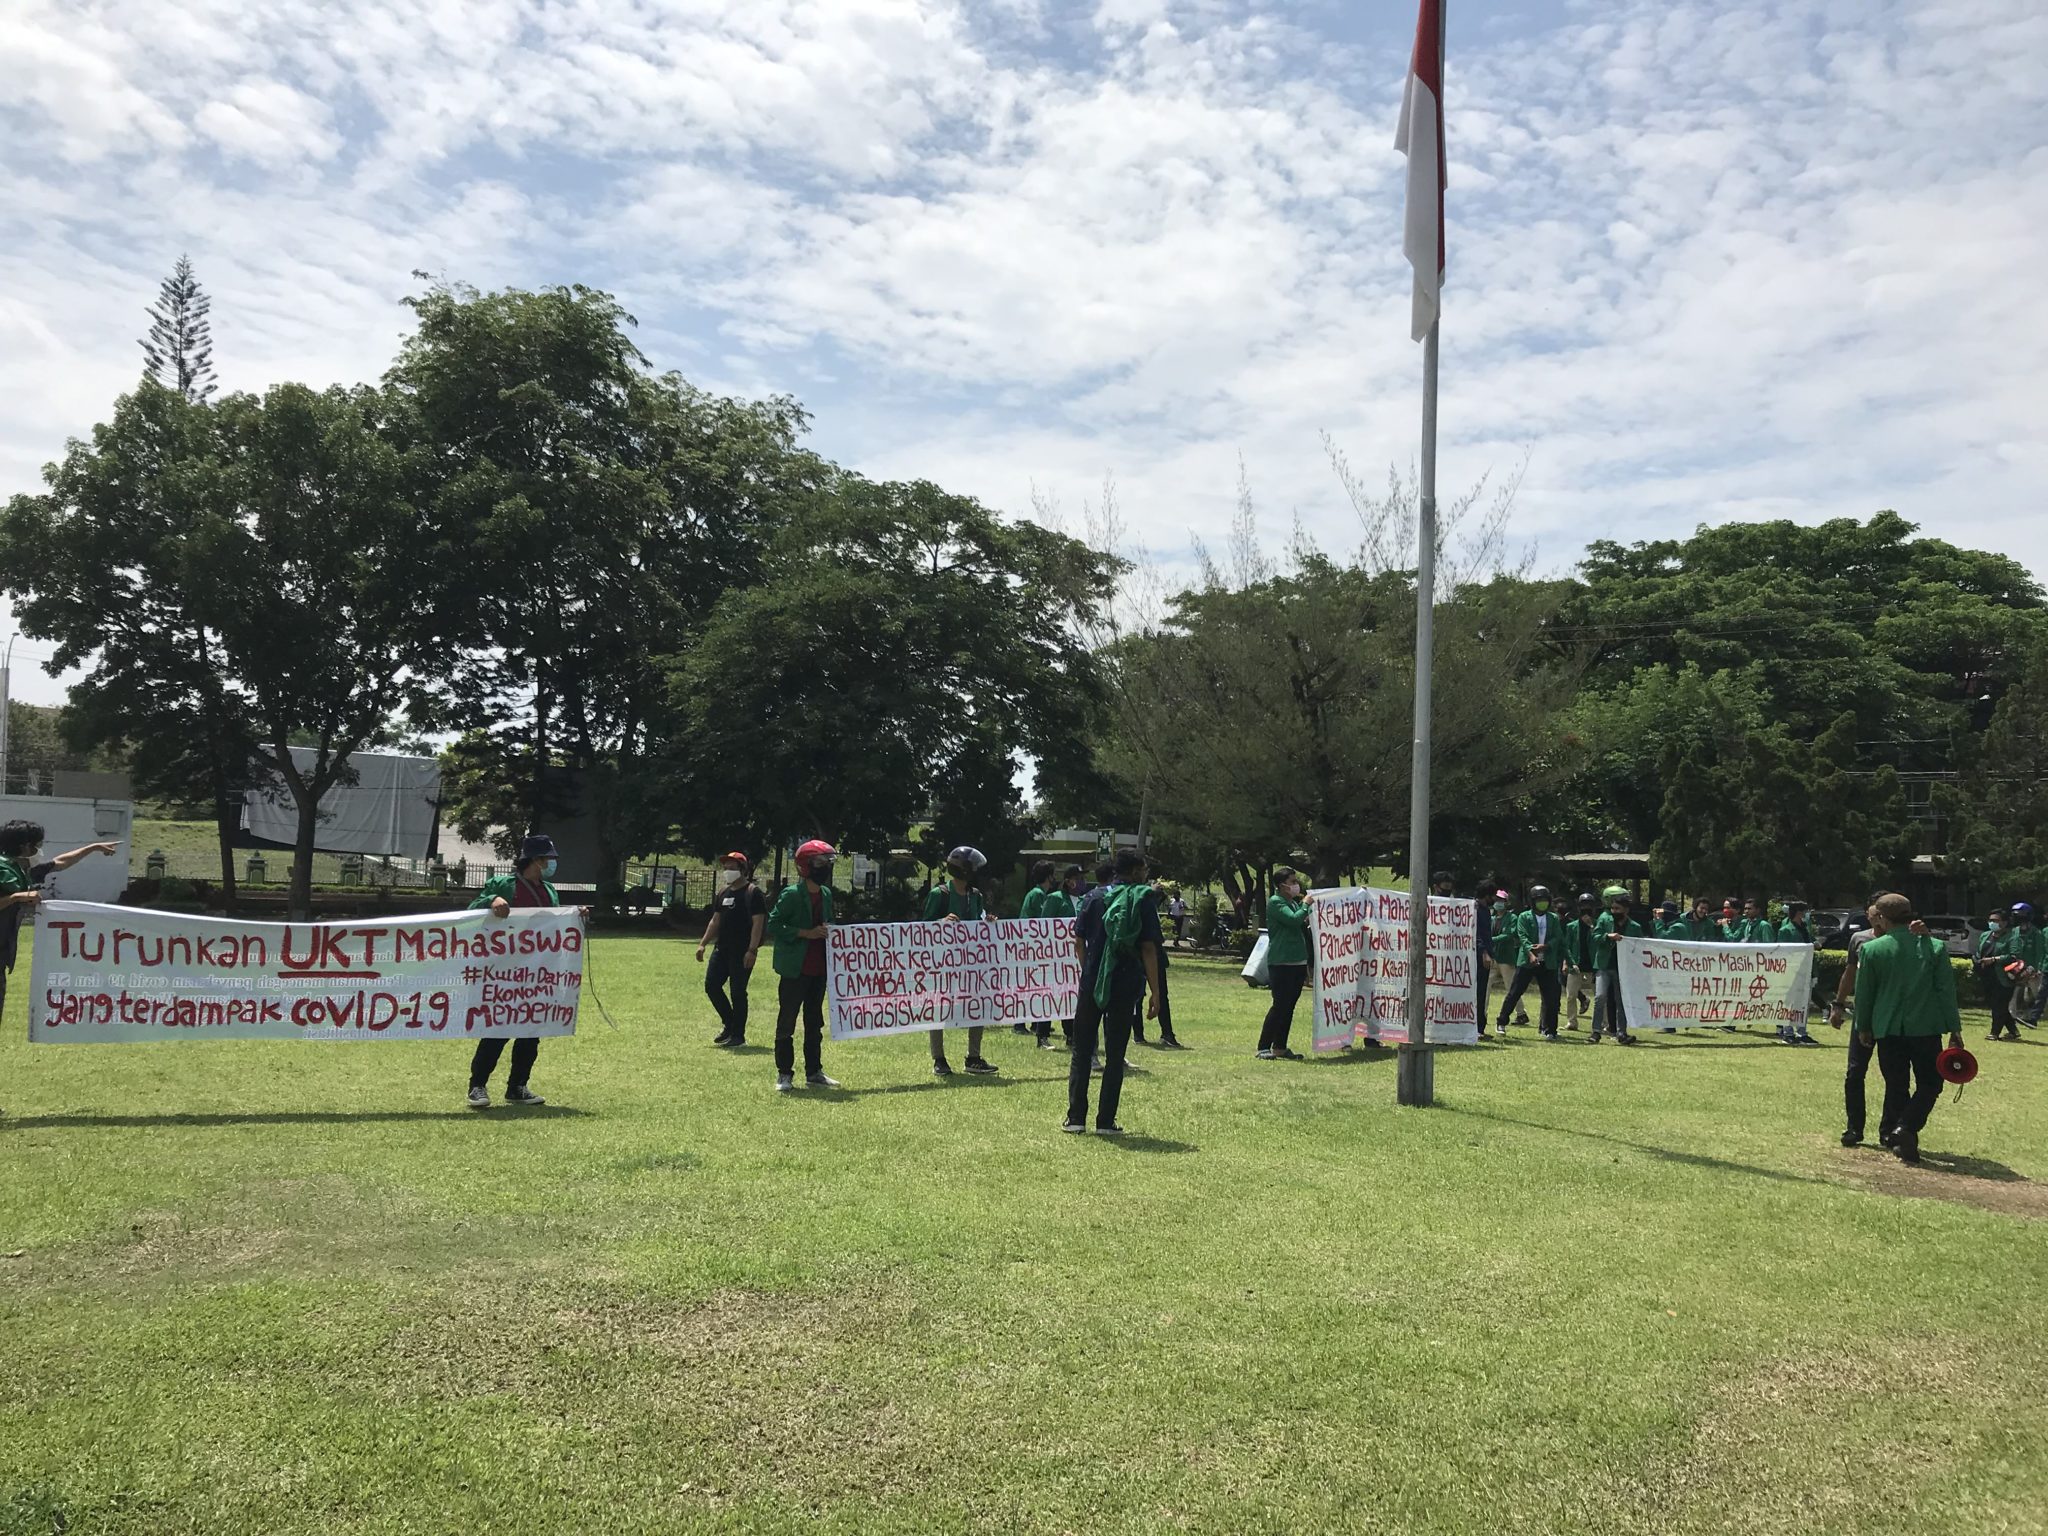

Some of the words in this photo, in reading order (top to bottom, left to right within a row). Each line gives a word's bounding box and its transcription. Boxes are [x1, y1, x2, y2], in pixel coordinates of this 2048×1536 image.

[46, 920, 267, 969] Turunkan
[280, 925, 389, 970] UKT
[396, 926, 582, 964] Mahasiswa
[899, 921, 991, 948] Mahasiswa
[995, 918, 1049, 941] UIN-SU
[913, 970, 927, 996] &
[929, 965, 1010, 995] Turunkan
[1016, 962, 1050, 990] UKT
[1642, 950, 1669, 970] Jika
[1672, 950, 1716, 973] Rektor
[1718, 952, 1754, 974] Masih
[45, 988, 114, 1028] yang
[116, 990, 284, 1027] terdampak
[837, 997, 935, 1032] Mahasiswa
[957, 992, 1026, 1021] Tengah
[1646, 996, 1698, 1020] Turunkan
[1700, 999, 1733, 1019] UKT
